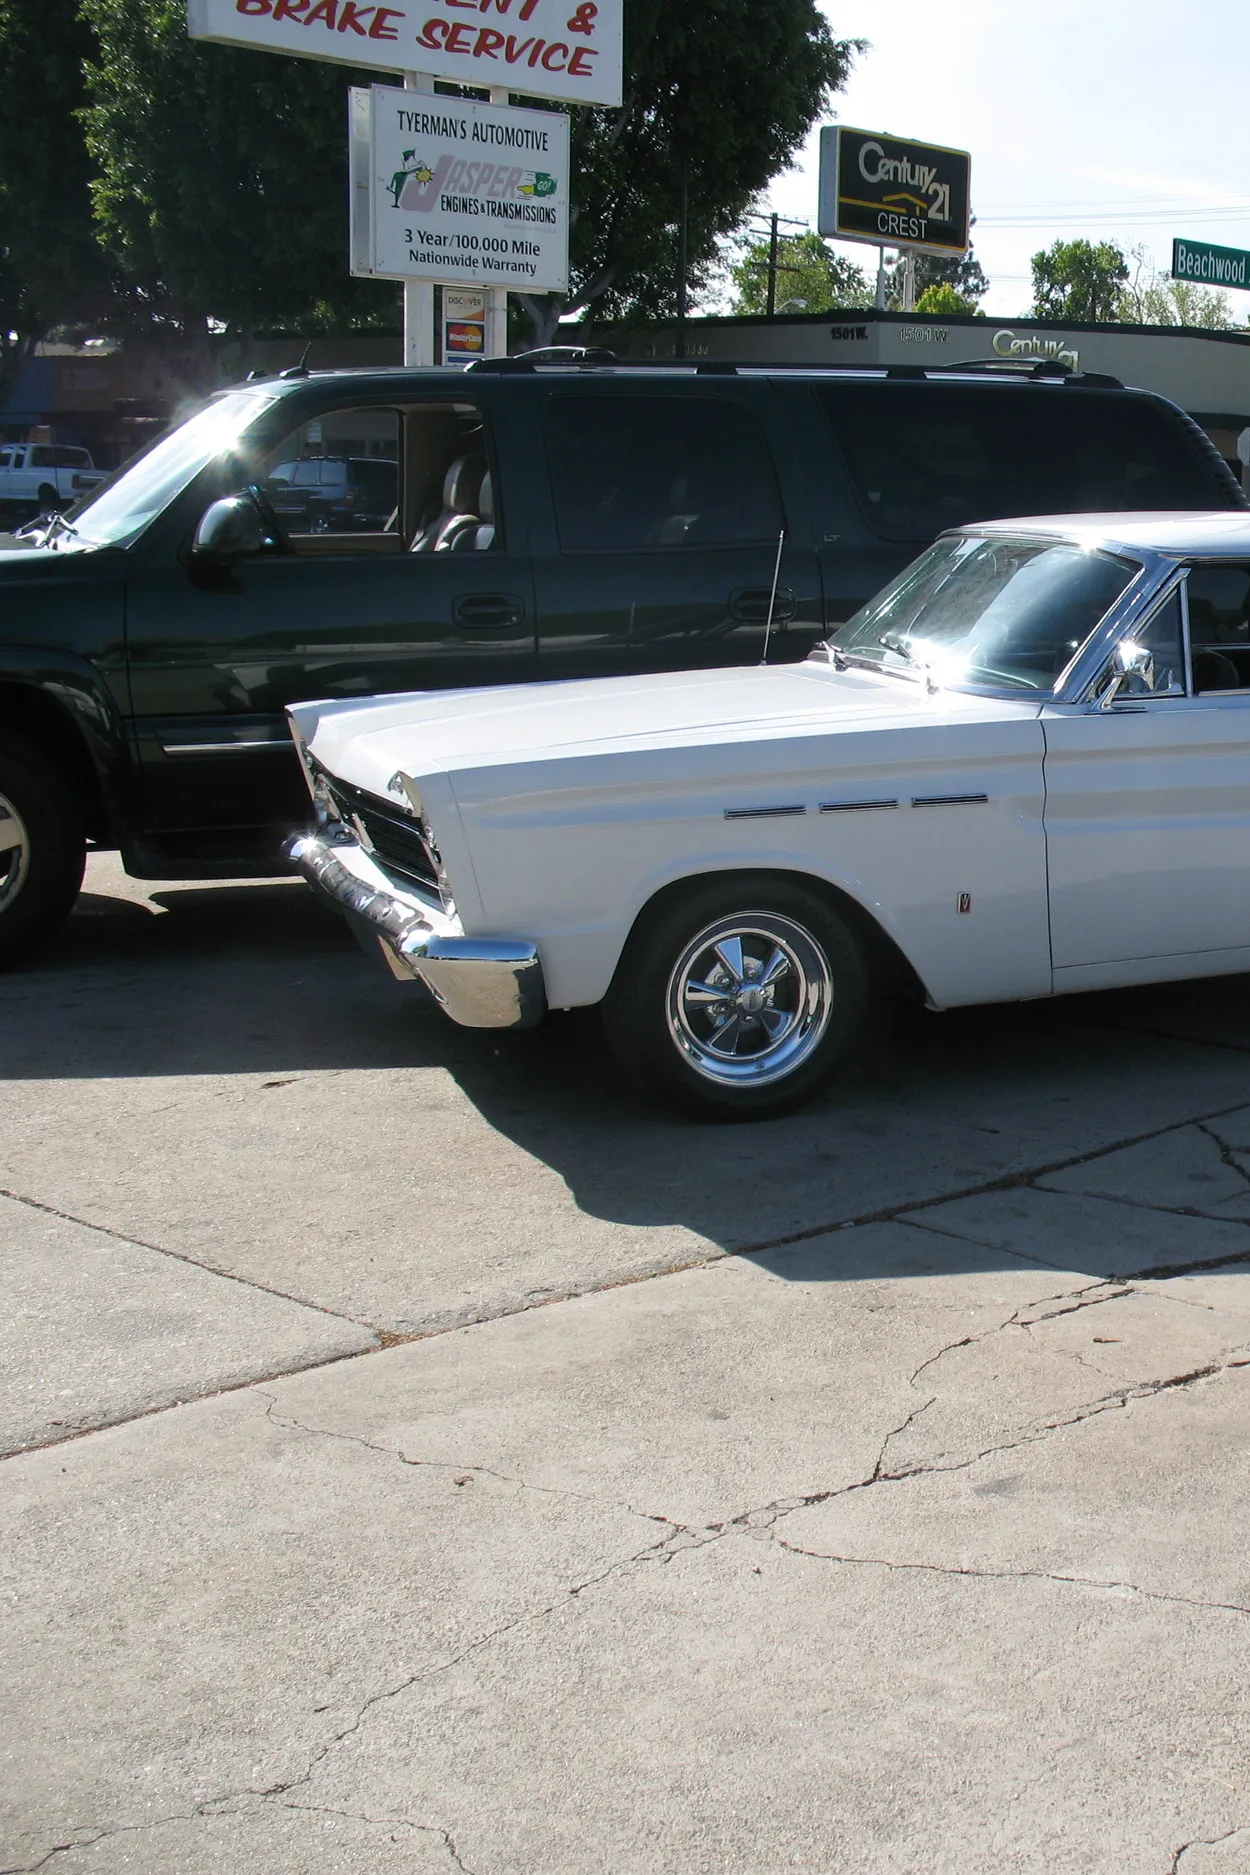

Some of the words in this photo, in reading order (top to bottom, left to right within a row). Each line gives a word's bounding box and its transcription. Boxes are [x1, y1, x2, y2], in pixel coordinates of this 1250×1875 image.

[567, 2, 598, 35] &
[235, 0, 405, 41] BRAKE
[416, 18, 599, 77] SERVICE
[397, 110, 466, 139] TYERMAN'S
[472, 122, 548, 151] AUTOMOTIVE
[400, 154, 524, 213] JASPER
[858, 141, 937, 193] Century
[928, 182, 950, 221] 21
[440, 194, 479, 215] ENGINES
[480, 203, 486, 213] &
[486, 200, 557, 224] TRANSMISSIONS
[877, 212, 927, 239] CREST
[405, 229, 413, 243] 3
[512, 241, 540, 256] Mile
[409, 250, 479, 268] Nationwide
[482, 257, 537, 276] Warranty
[1177, 246, 1245, 284] Beachwood
[992, 329, 1065, 359] Century
